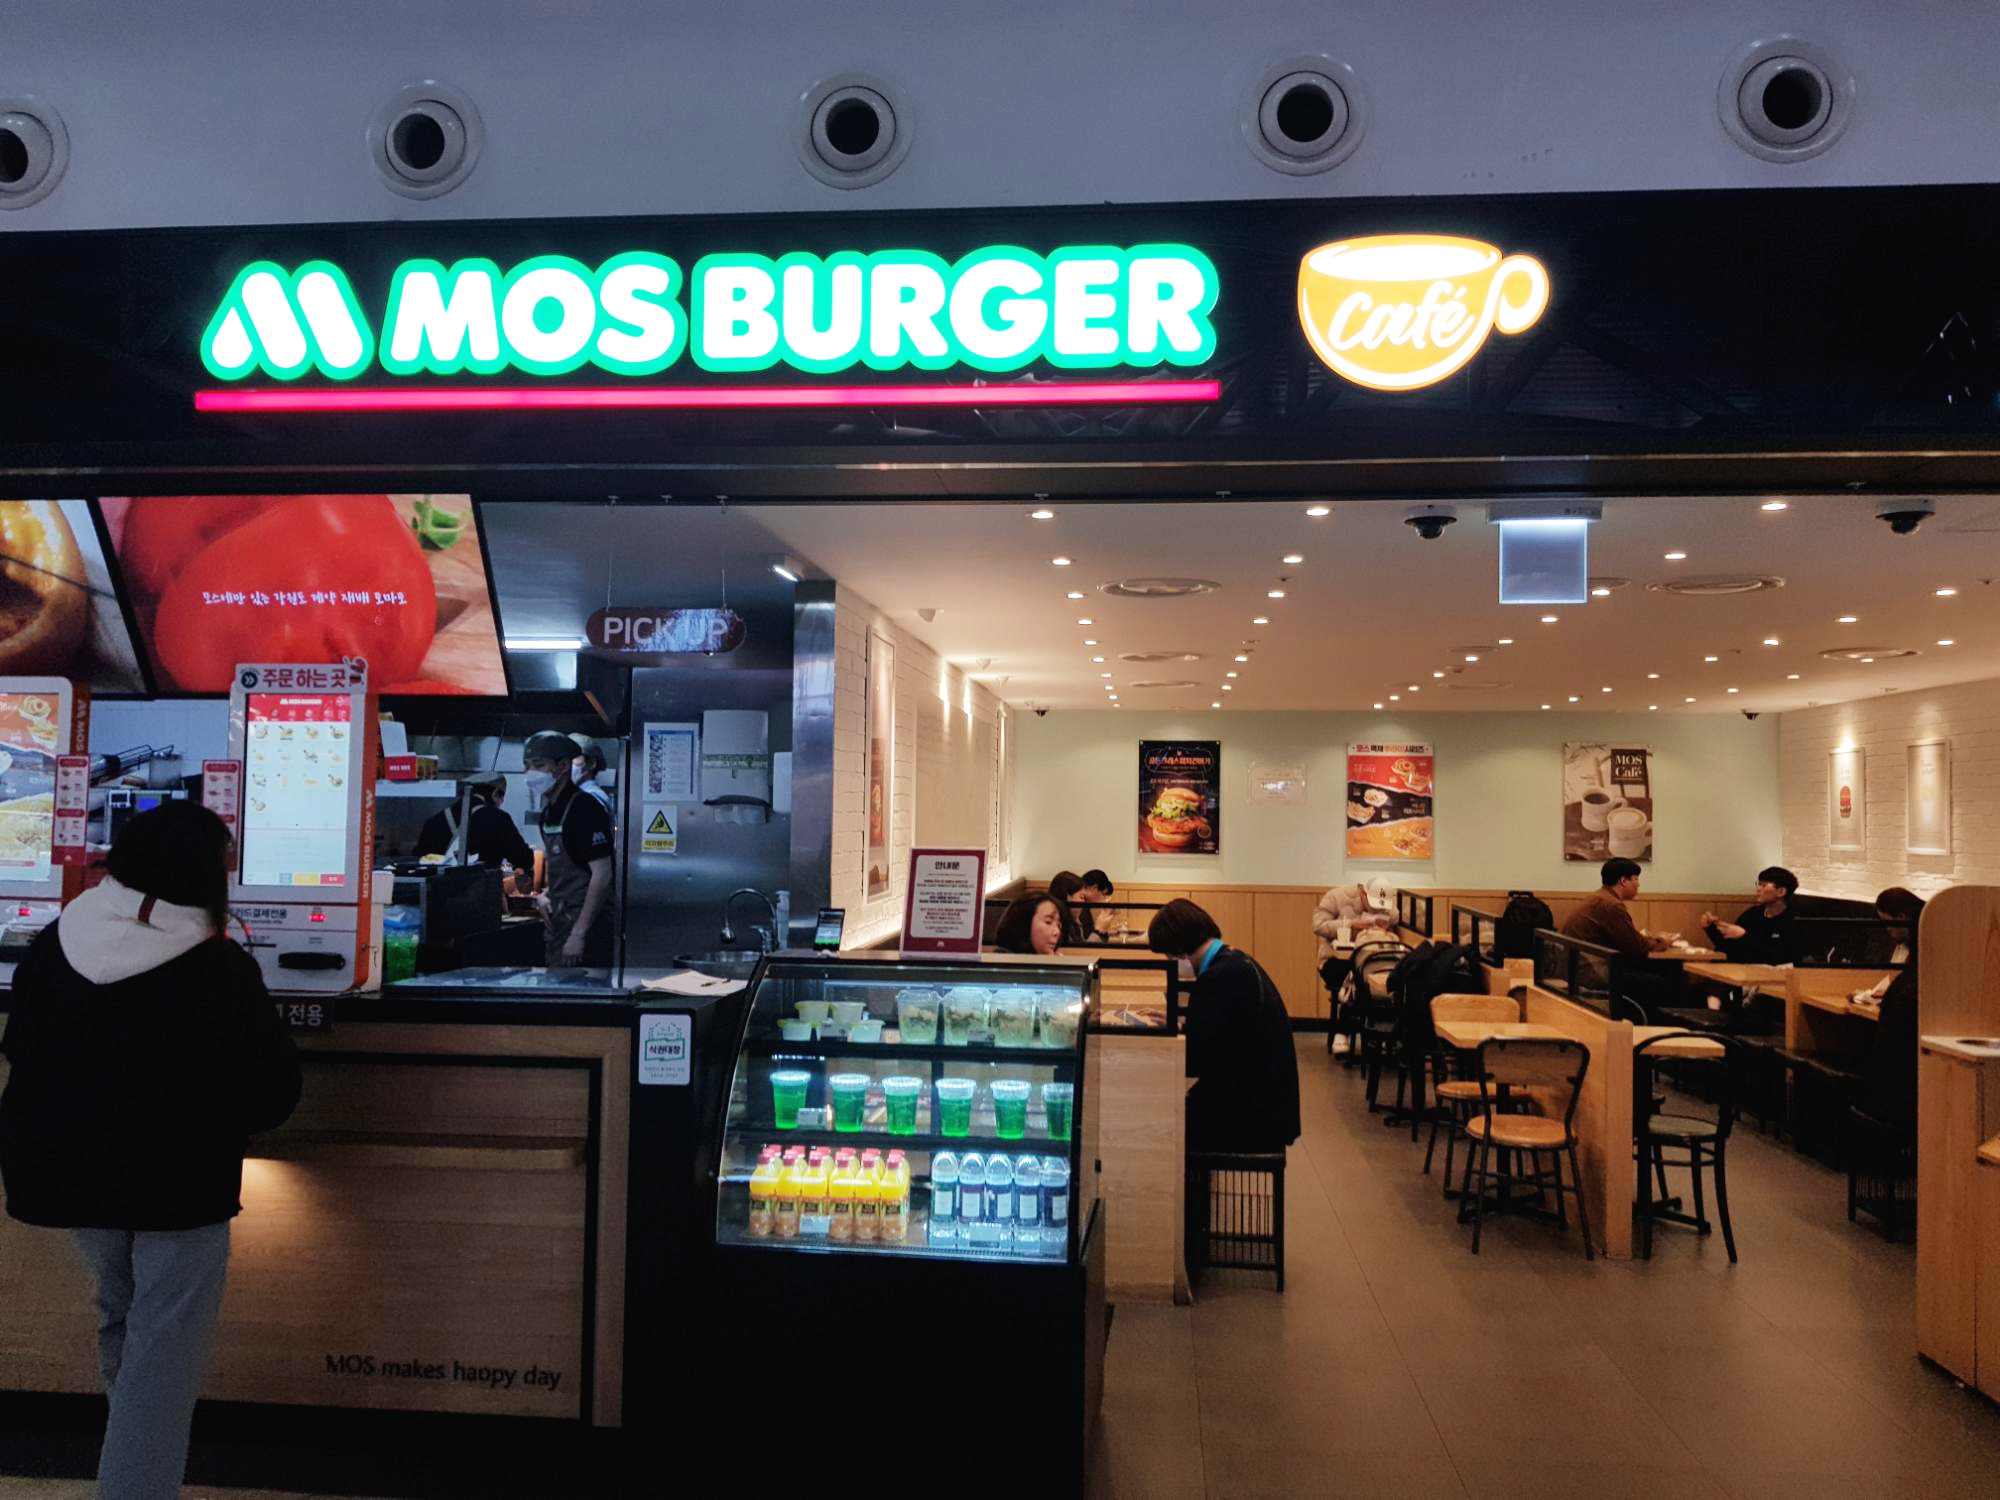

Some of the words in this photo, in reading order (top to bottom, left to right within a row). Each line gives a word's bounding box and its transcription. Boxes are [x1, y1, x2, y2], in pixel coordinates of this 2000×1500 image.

[385, 256, 682, 370] MOS
[697, 250, 1213, 368] BURGER
[1327, 280, 1474, 350] Café
[273, 591, 307, 606] 강원도
[341, 591, 370, 604] 재배
[374, 591, 408, 605] 토마토
[603, 616, 676, 644] PICK
[262, 668, 293, 688] 주문
[296, 668, 327, 688] 하는
[331, 668, 346, 688] 곳
[76, 724, 85, 752] MOS
[1615, 754, 1643, 766] MOS
[1615, 766, 1642, 778] Café
[364, 812, 373, 843] MOS
[361, 845, 371, 899] BURGER
[934, 860, 960, 871] 안내문
[287, 1003, 325, 1026] 전용
[648, 1044, 681, 1056] 식권대장
[325, 1354, 375, 1376] MOS
[381, 1358, 446, 1380] makes
[523, 1365, 562, 1391] day
